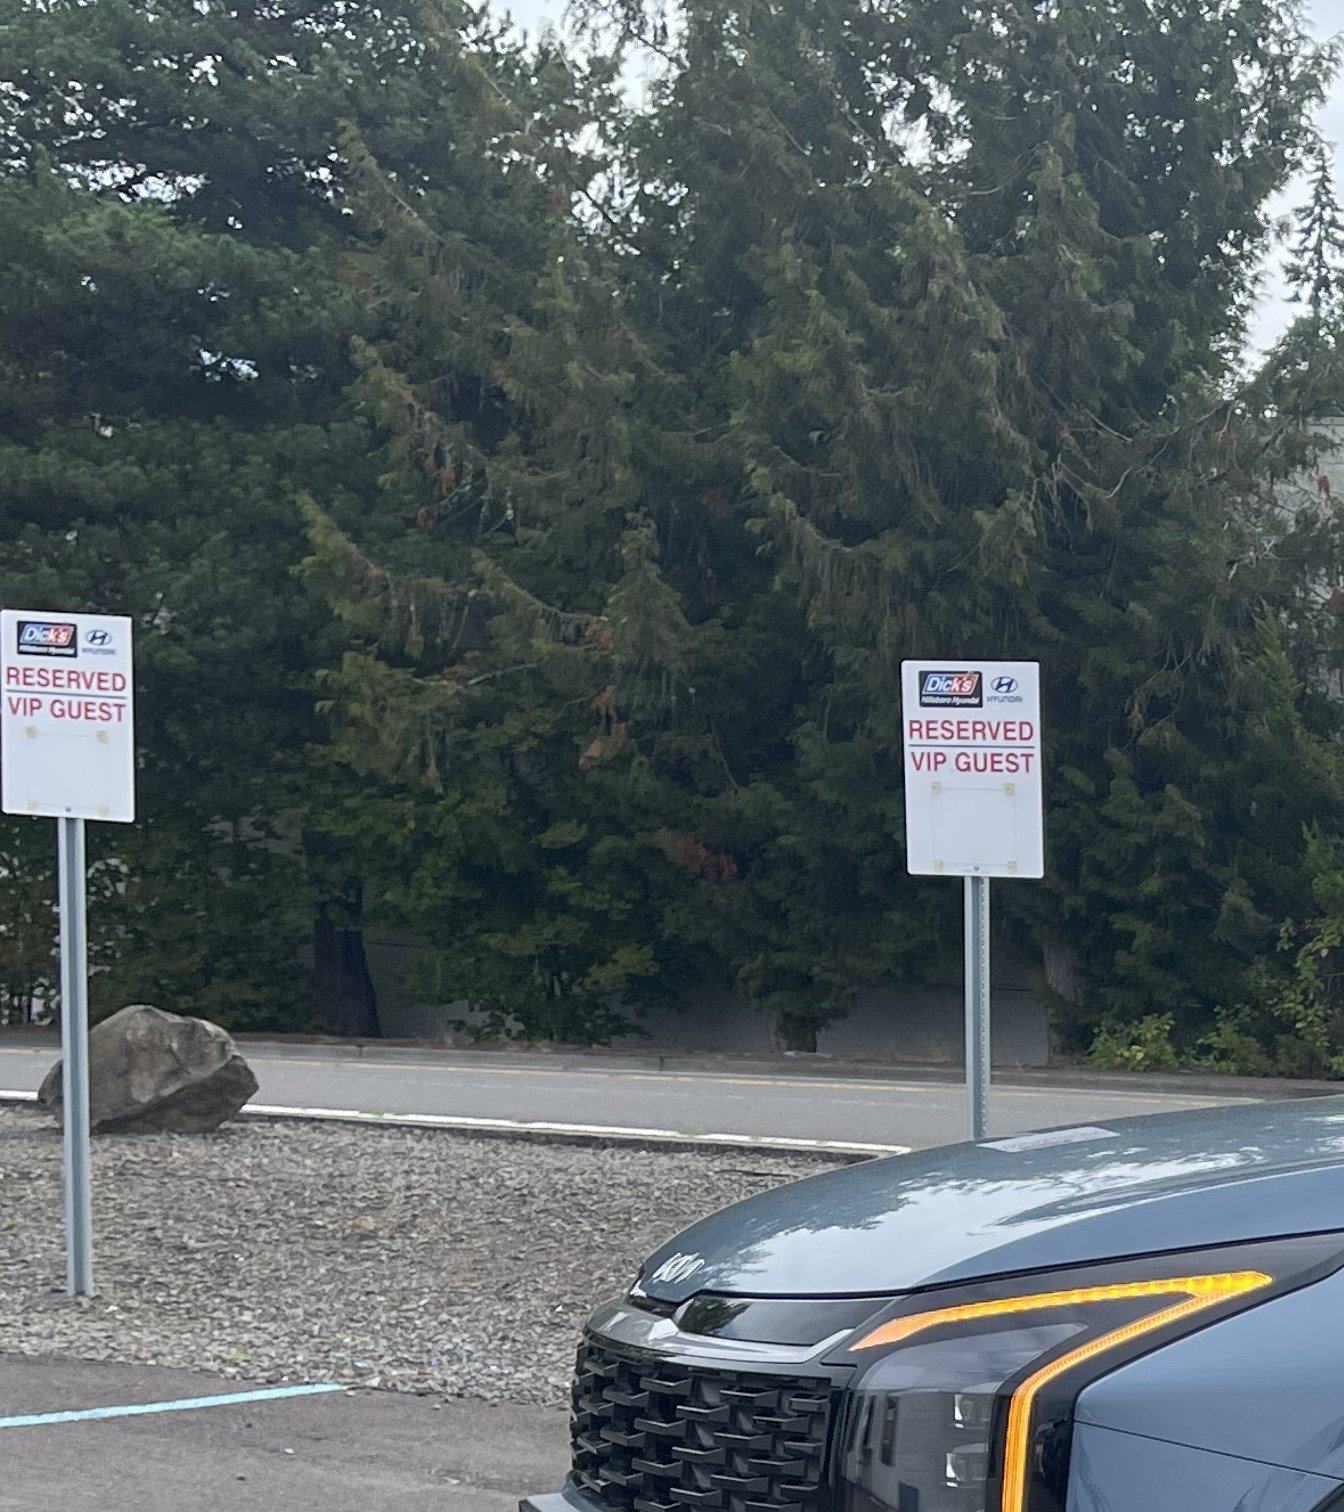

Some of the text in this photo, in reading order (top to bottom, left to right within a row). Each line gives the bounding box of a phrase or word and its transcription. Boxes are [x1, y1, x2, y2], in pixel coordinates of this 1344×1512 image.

[6, 666, 127, 693] RESERVED
[7, 696, 127, 723] VIP GUEST
[908, 719, 1034, 742] RESERVED
[911, 751, 1035, 774] VIP GUEST
